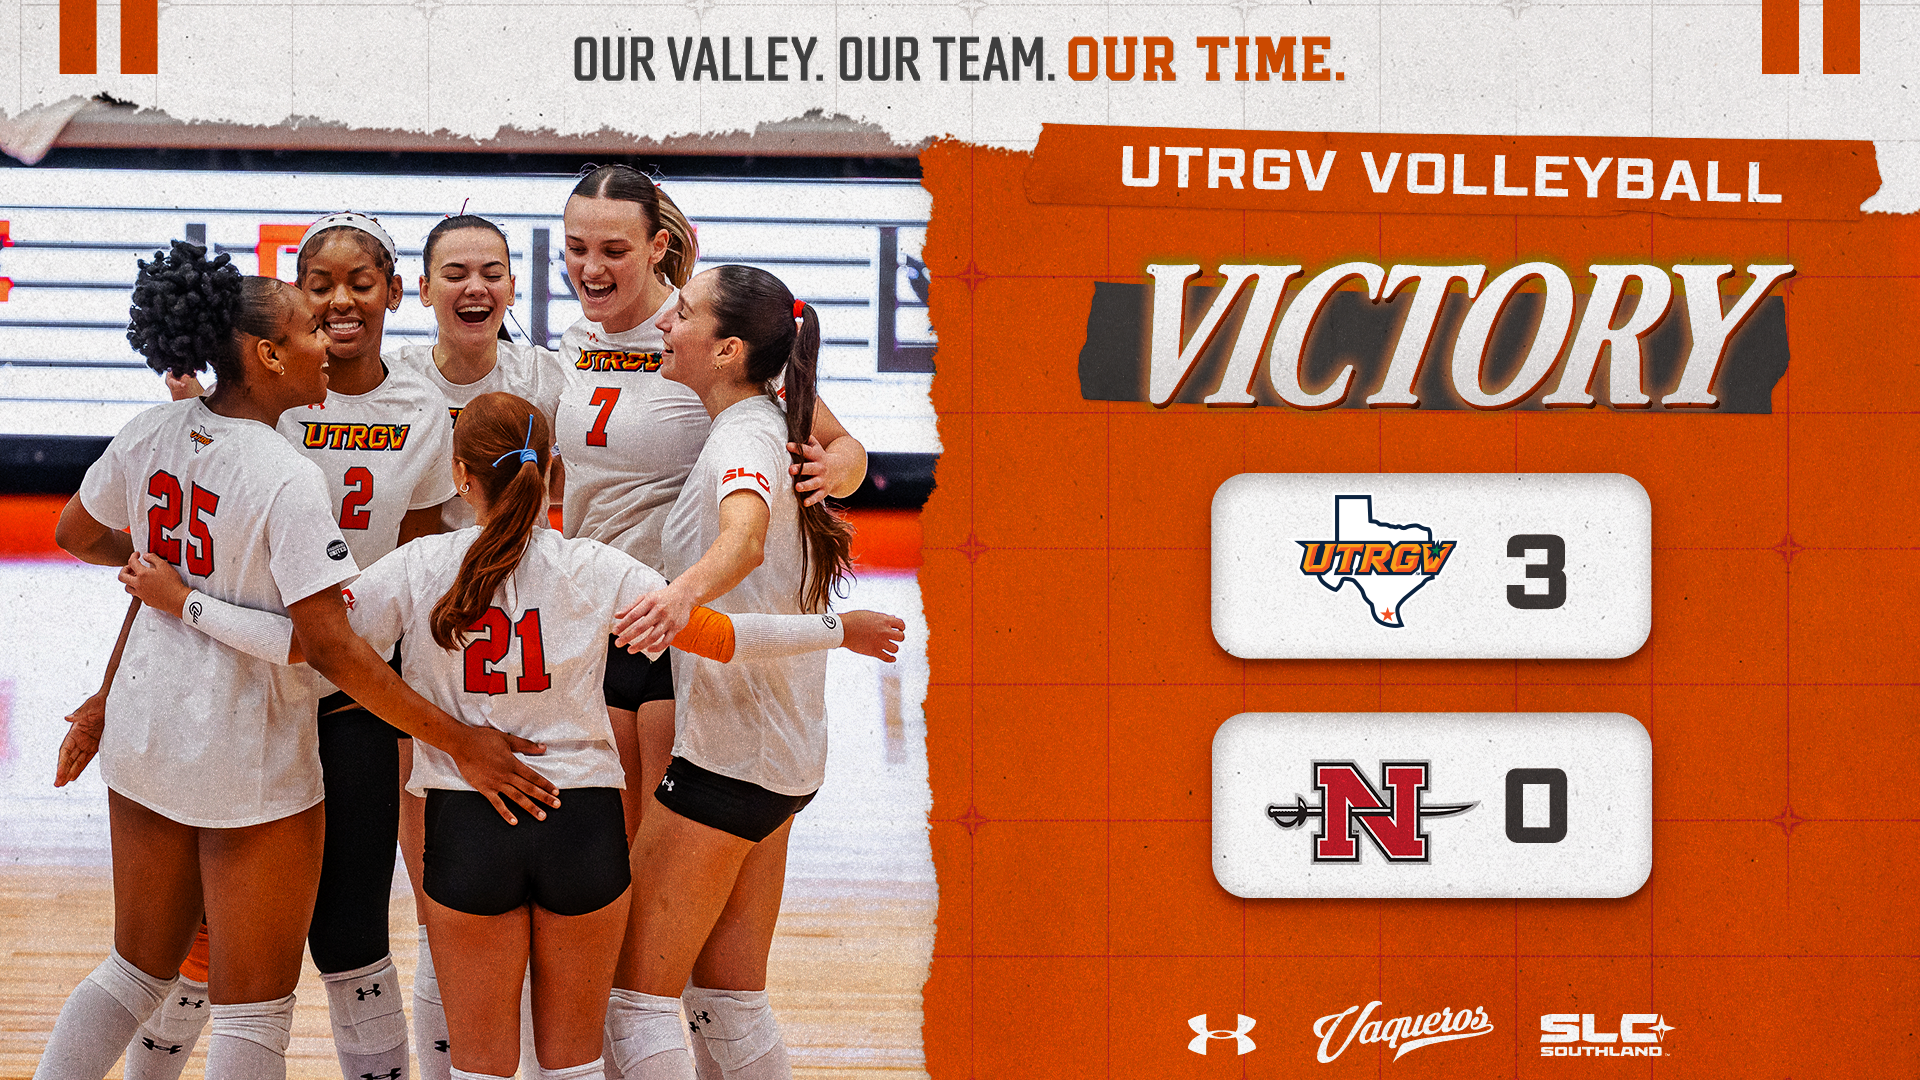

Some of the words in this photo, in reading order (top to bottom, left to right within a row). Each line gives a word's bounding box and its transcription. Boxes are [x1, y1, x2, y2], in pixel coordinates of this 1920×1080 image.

[299, 422, 411, 451] UTRGV
[586, 386, 622, 448] 7
[339, 466, 374, 530] 2
[721, 467, 771, 494] SLC
[147, 469, 220, 579] 25
[463, 606, 552, 696] 21
